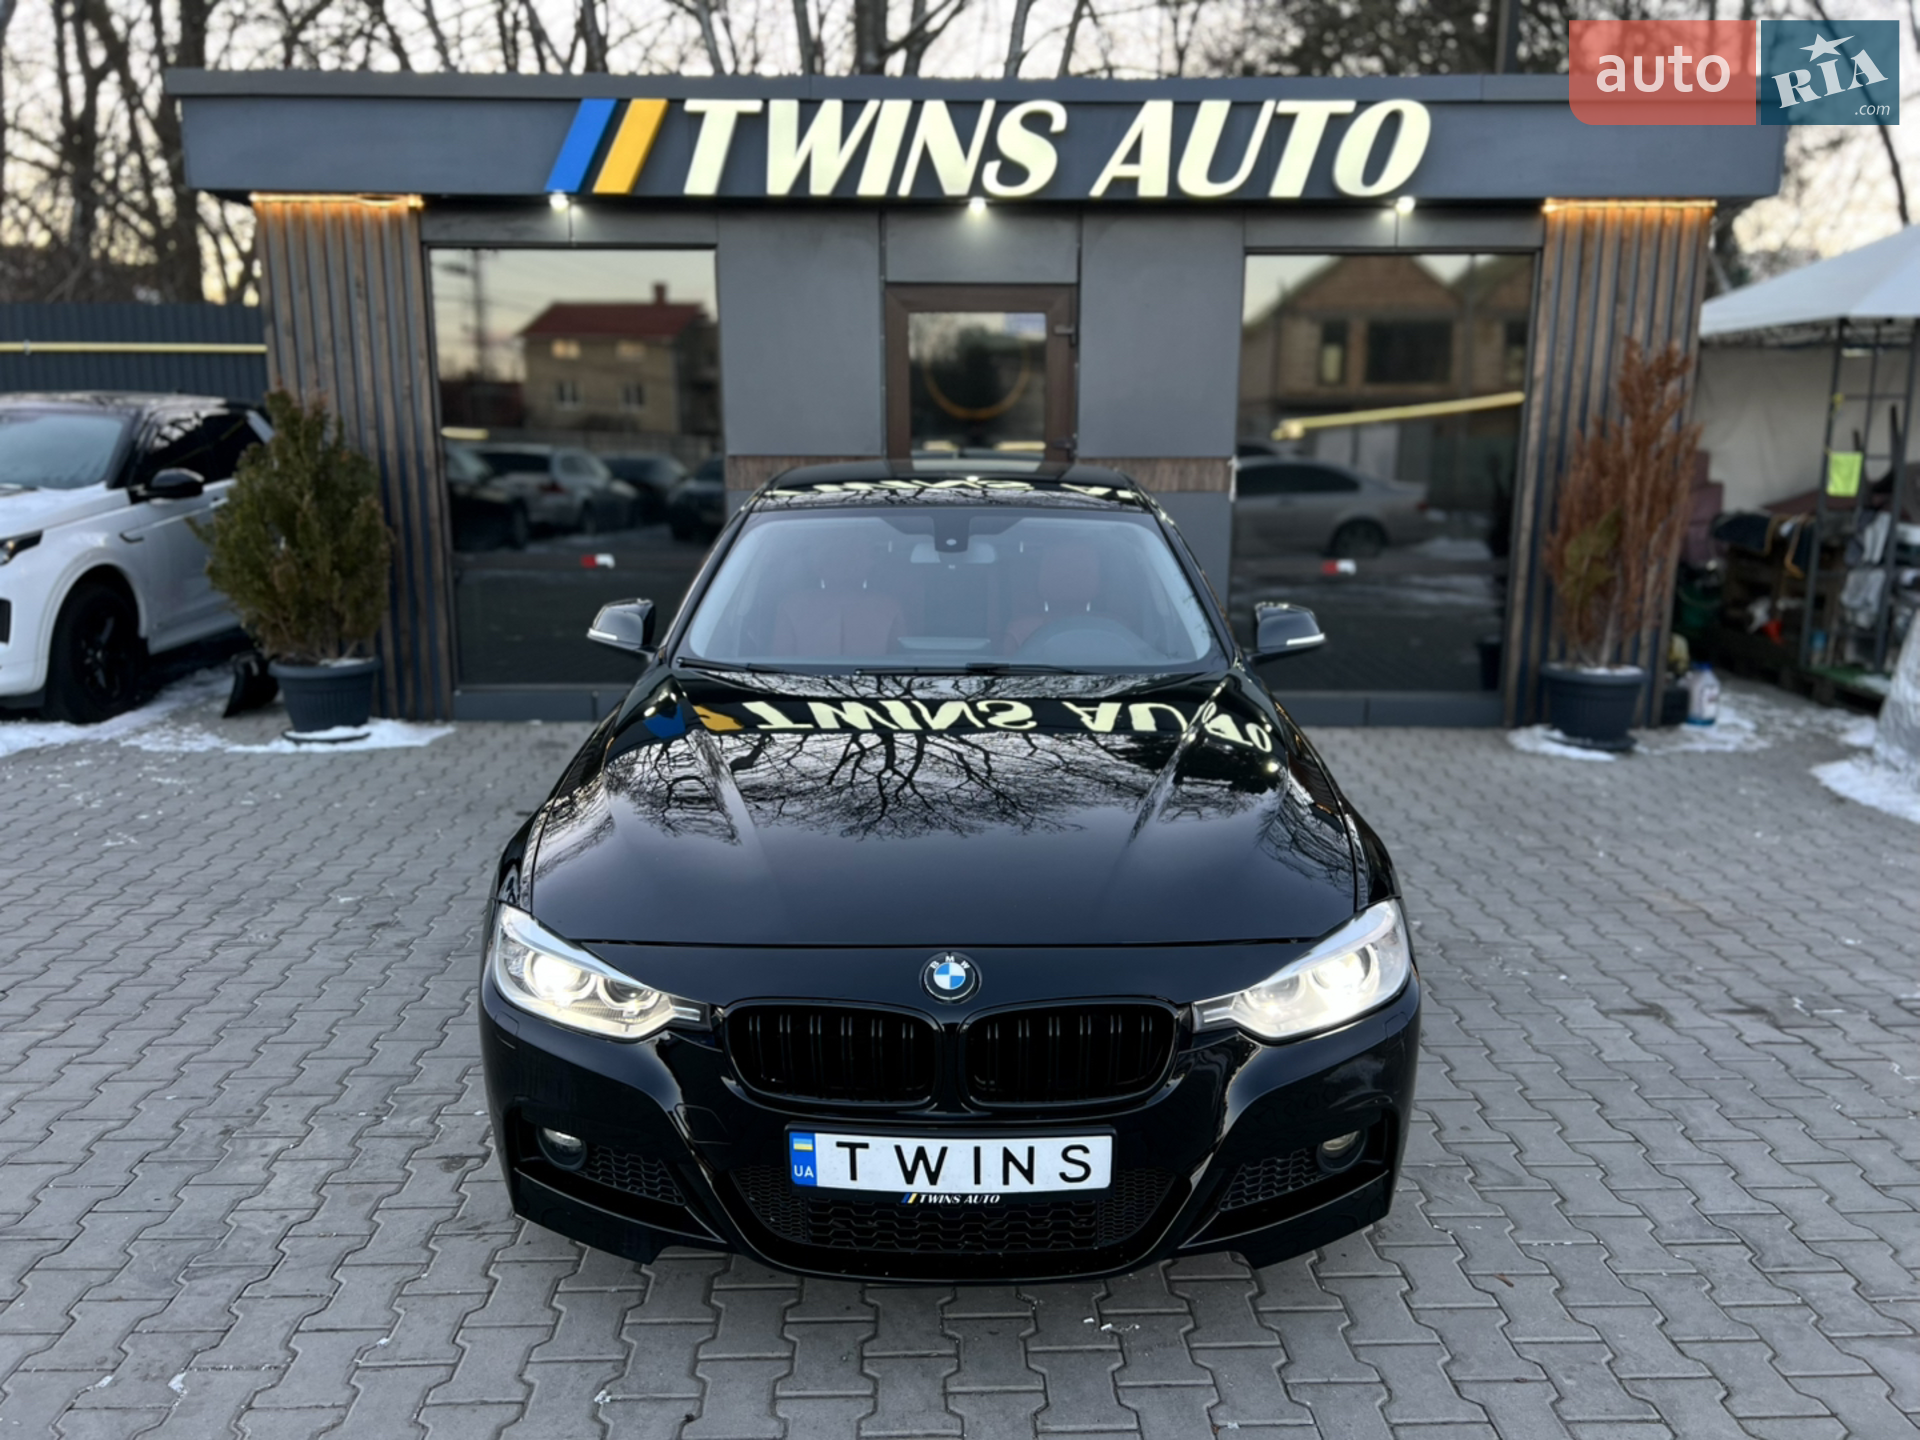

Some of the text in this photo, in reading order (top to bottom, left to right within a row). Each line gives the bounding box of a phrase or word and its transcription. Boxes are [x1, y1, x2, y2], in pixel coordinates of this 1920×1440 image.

[683, 99, 1432, 198] TWINS AUTO
[929, 955, 971, 969] BMW
[793, 1164, 815, 1178] UA
[919, 1194, 1001, 1205] TWINS AUTO
